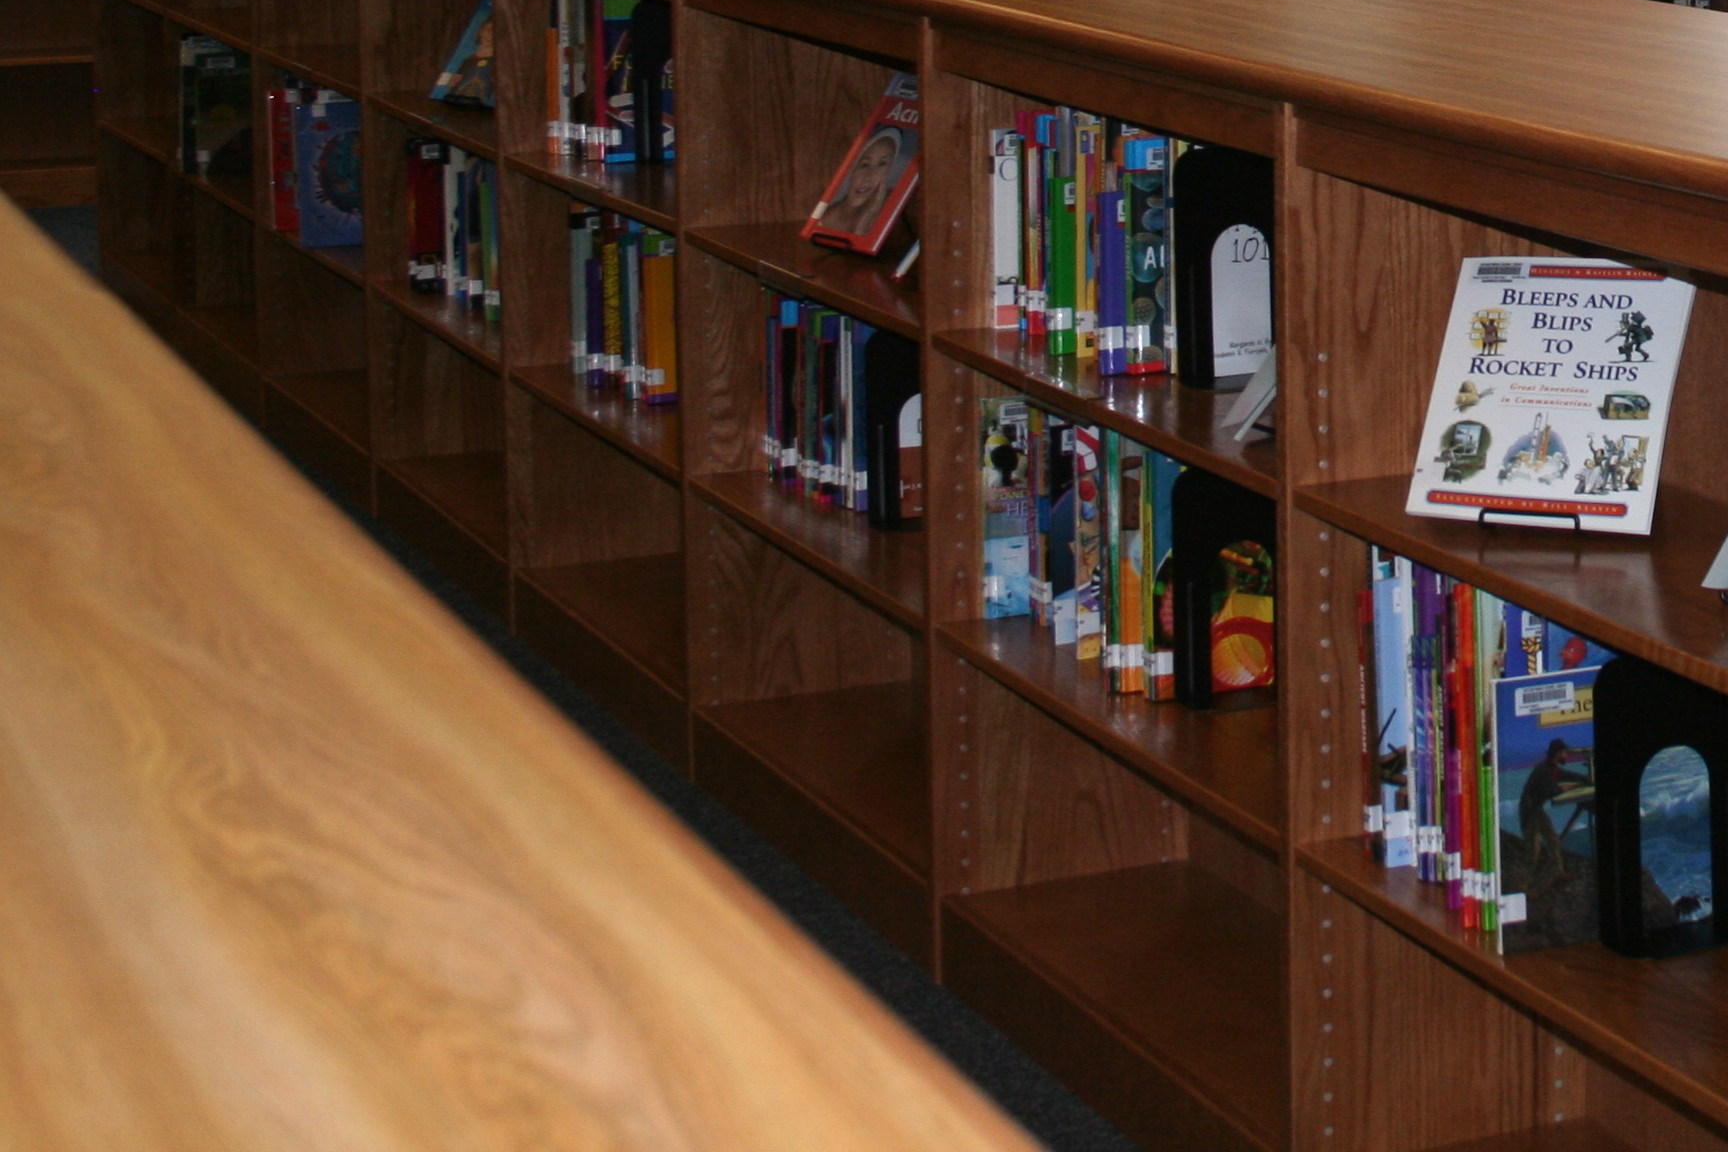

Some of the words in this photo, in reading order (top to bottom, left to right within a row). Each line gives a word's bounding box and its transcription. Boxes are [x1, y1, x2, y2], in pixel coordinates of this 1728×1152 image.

[1232, 237, 1270, 263] 101
[1500, 288, 1579, 308] BLEEPS
[1583, 294, 1633, 310] AND
[1531, 312, 1593, 332] BLIPS
[1542, 338, 1573, 354] TO
[1468, 357, 1563, 377] ROCKET
[1573, 361, 1639, 382] SHIPS
